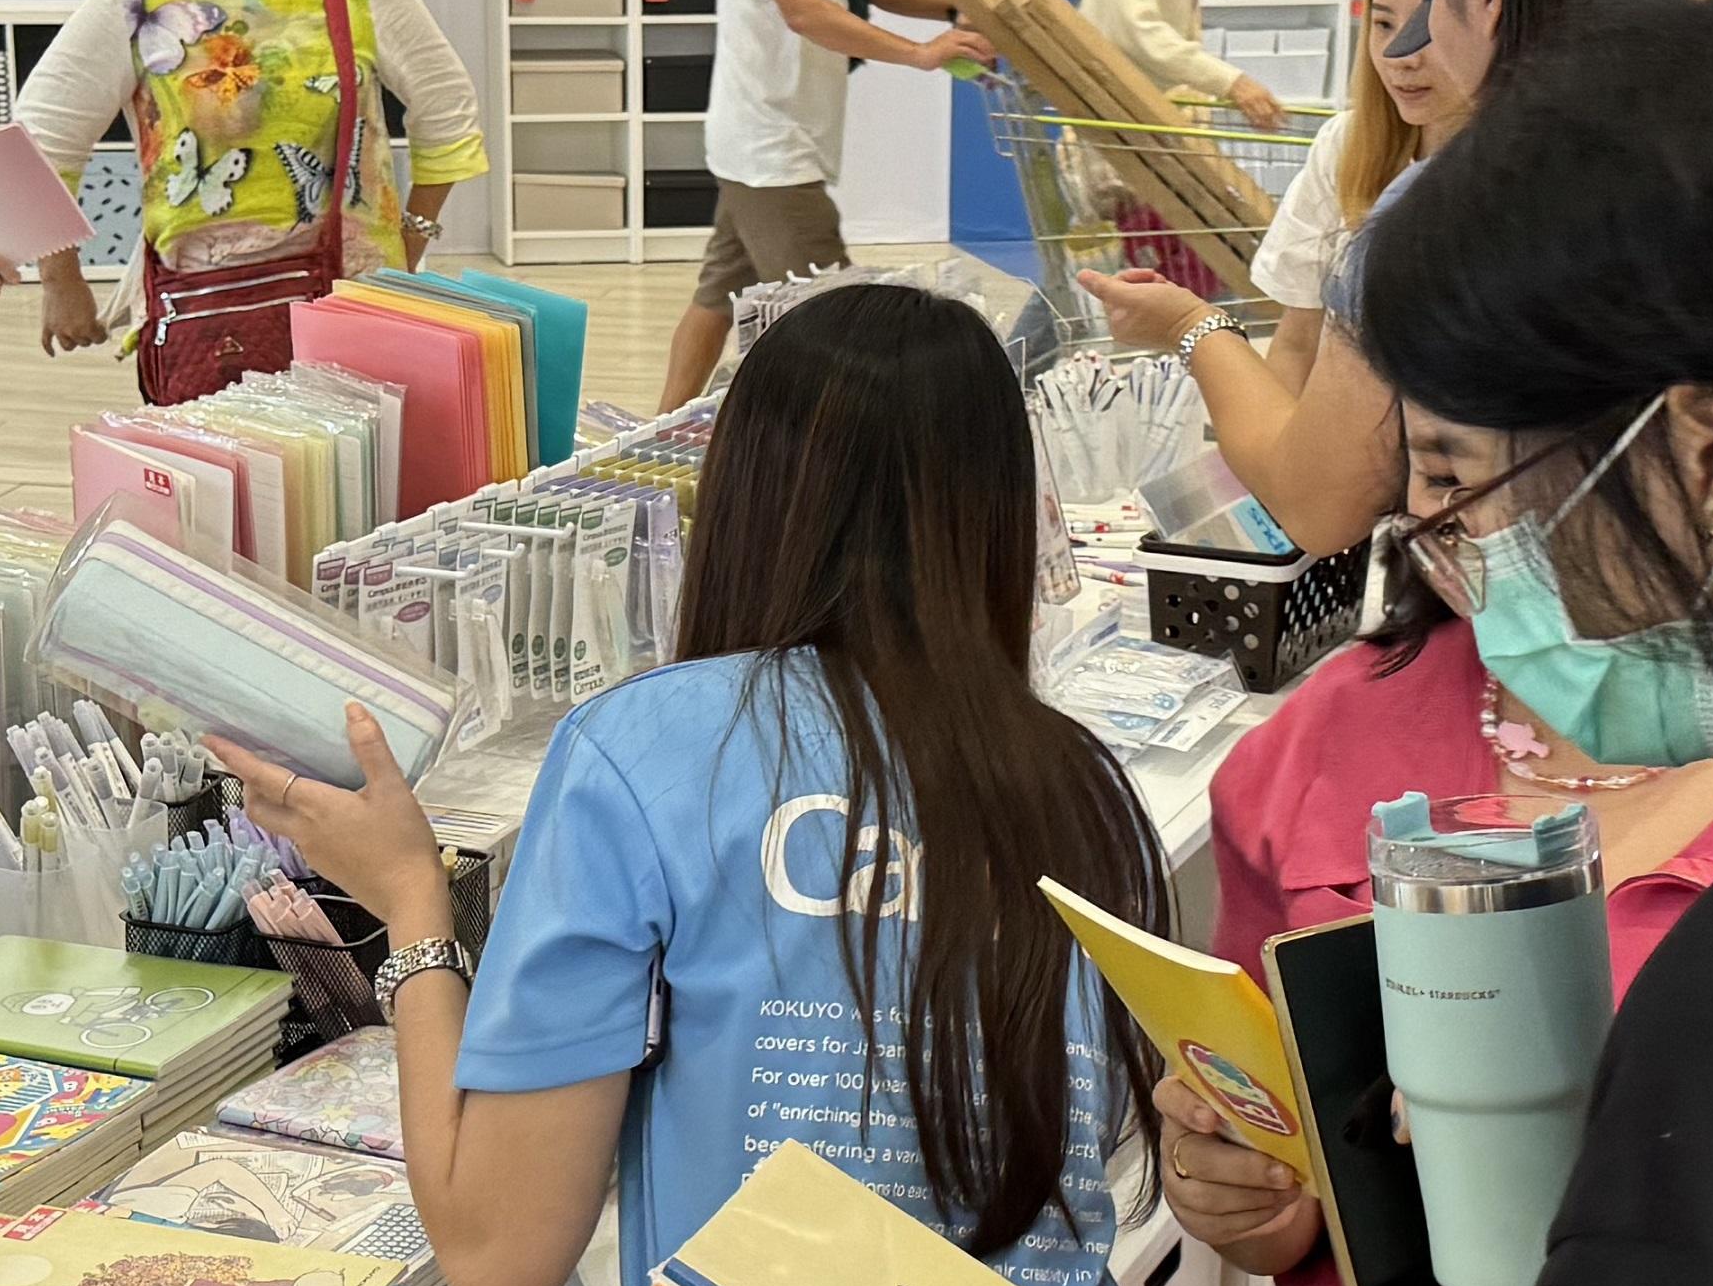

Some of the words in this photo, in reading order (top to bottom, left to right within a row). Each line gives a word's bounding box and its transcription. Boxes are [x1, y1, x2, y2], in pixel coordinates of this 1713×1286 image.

[760, 999, 844, 1020] KOKUYO
[754, 1035, 816, 1053] covers
[822, 1036, 851, 1054] for
[751, 1067, 783, 1085] For
[787, 1072, 830, 1088] over
[835, 1073, 864, 1090] 100
[747, 1101, 767, 1118] of
[869, 1109, 897, 1128] the
[743, 1133, 781, 1153] bee
